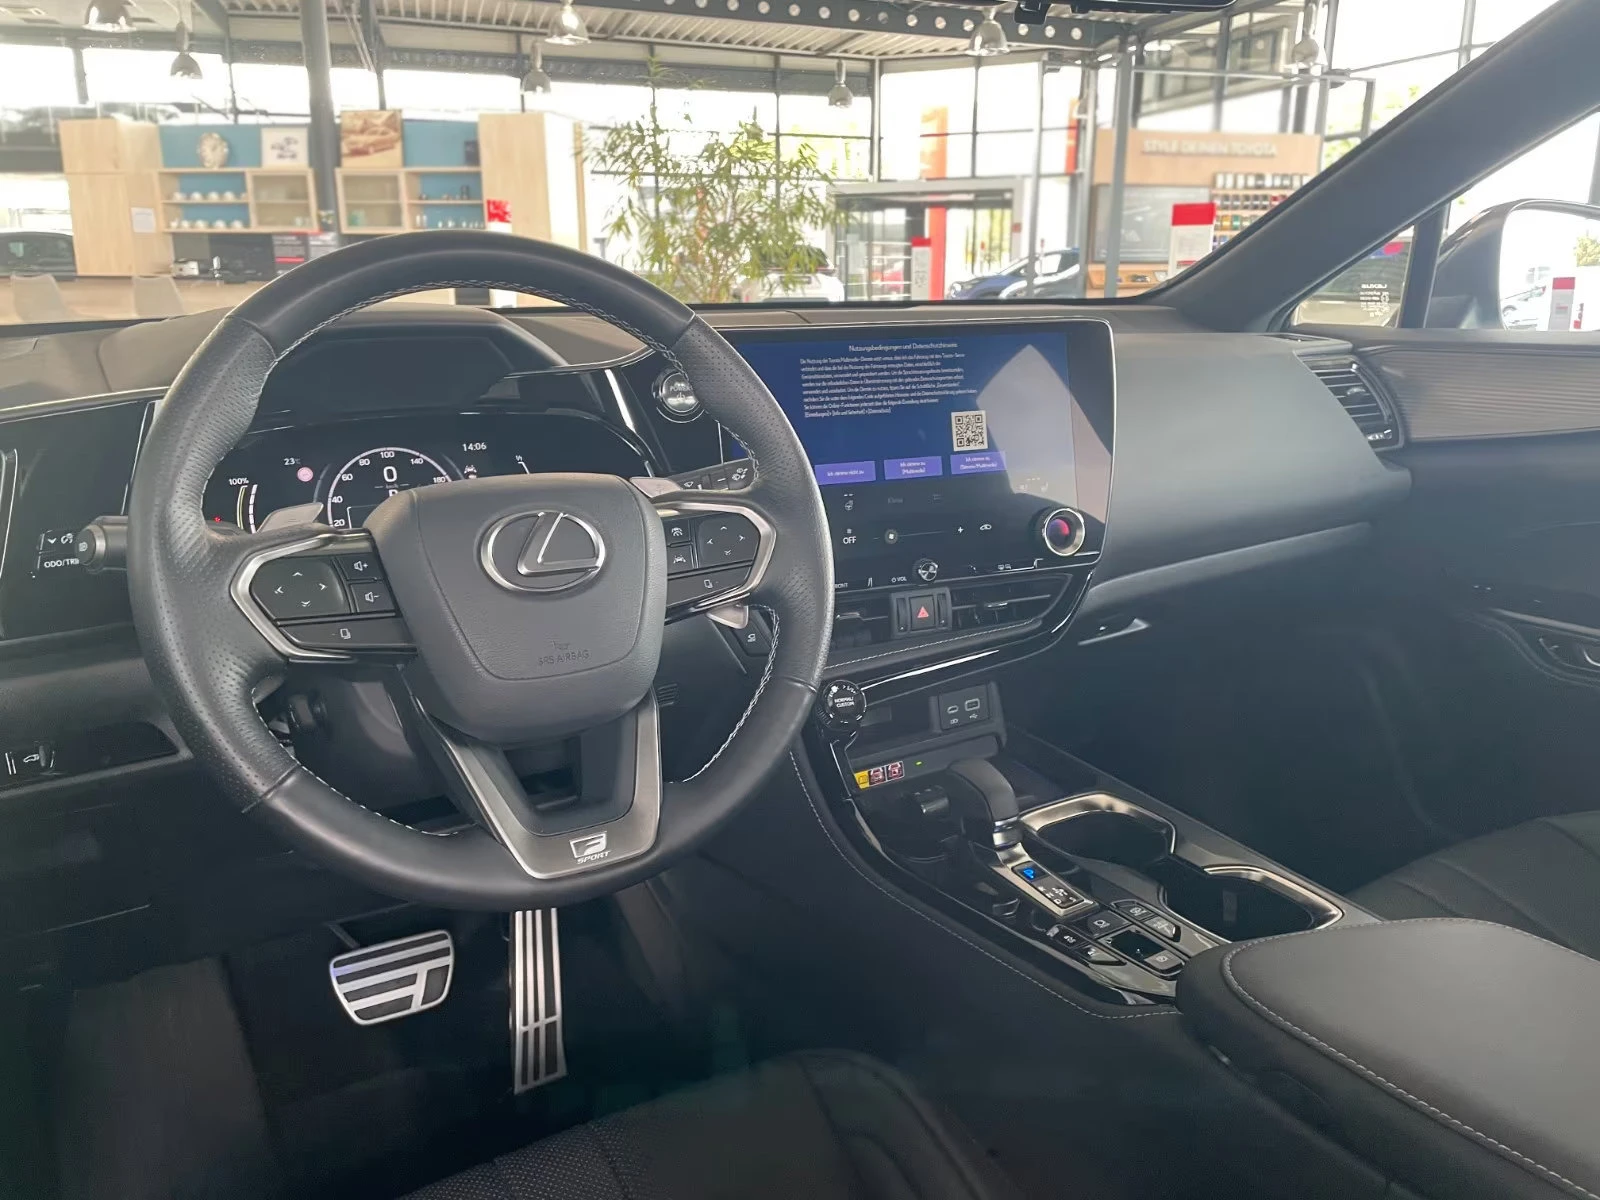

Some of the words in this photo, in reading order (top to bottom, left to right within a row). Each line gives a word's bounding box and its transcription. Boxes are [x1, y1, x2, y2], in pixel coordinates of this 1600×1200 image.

[1143, 139, 1179, 154] STYLE
[1231, 141, 1277, 156] TOYOTA
[462, 442, 487, 452] 14:06
[380, 451, 395, 459] 100
[359, 458, 370, 466] 80
[341, 473, 353, 481] 60
[383, 466, 398, 482] 0
[229, 477, 249, 486] 100%
[331, 495, 343, 503] 40
[334, 519, 346, 527] 20
[843, 536, 856, 544] OFF
[538, 655, 554, 666] SRS
[556, 649, 590, 663] AIRBAG
[577, 850, 611, 864] SPORT
